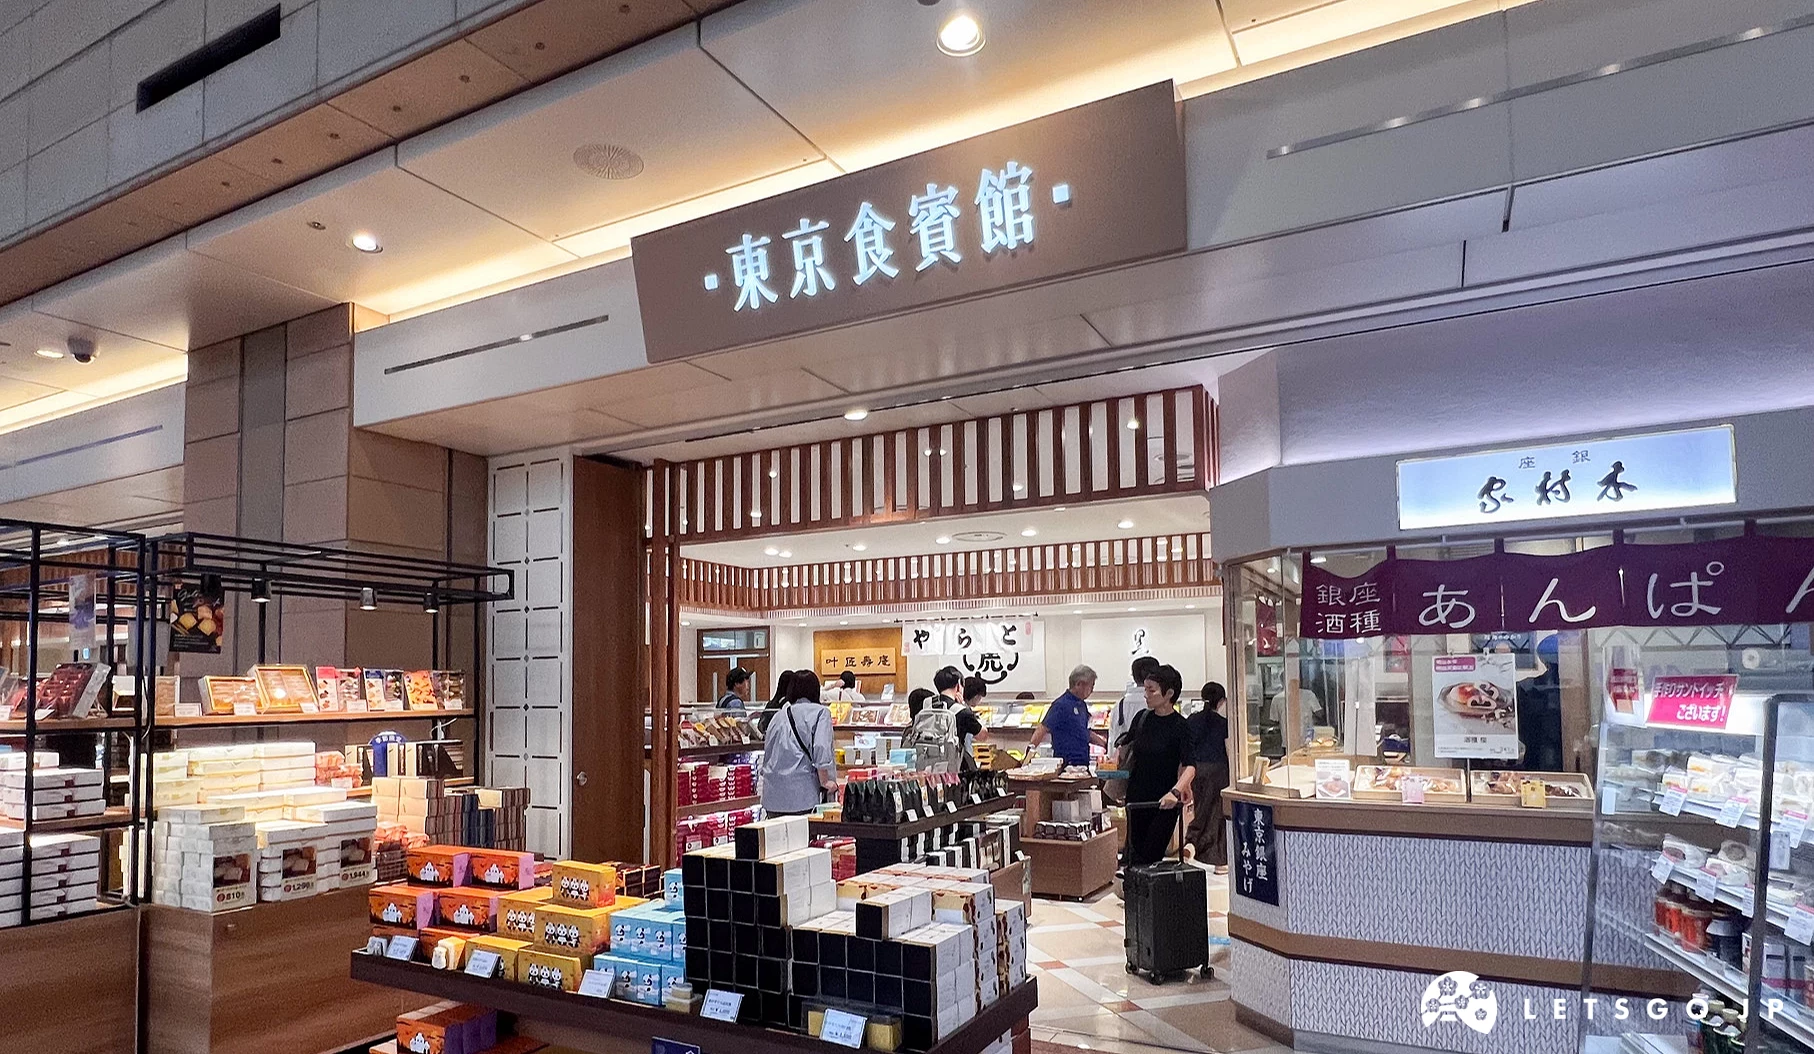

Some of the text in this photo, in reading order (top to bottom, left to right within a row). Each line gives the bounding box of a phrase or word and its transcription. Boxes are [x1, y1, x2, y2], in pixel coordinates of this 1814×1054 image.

[1315, 582, 1381, 606] 銀座
[1315, 609, 1382, 633] 酒種
[1253, 808, 1268, 881] 東京銀座
